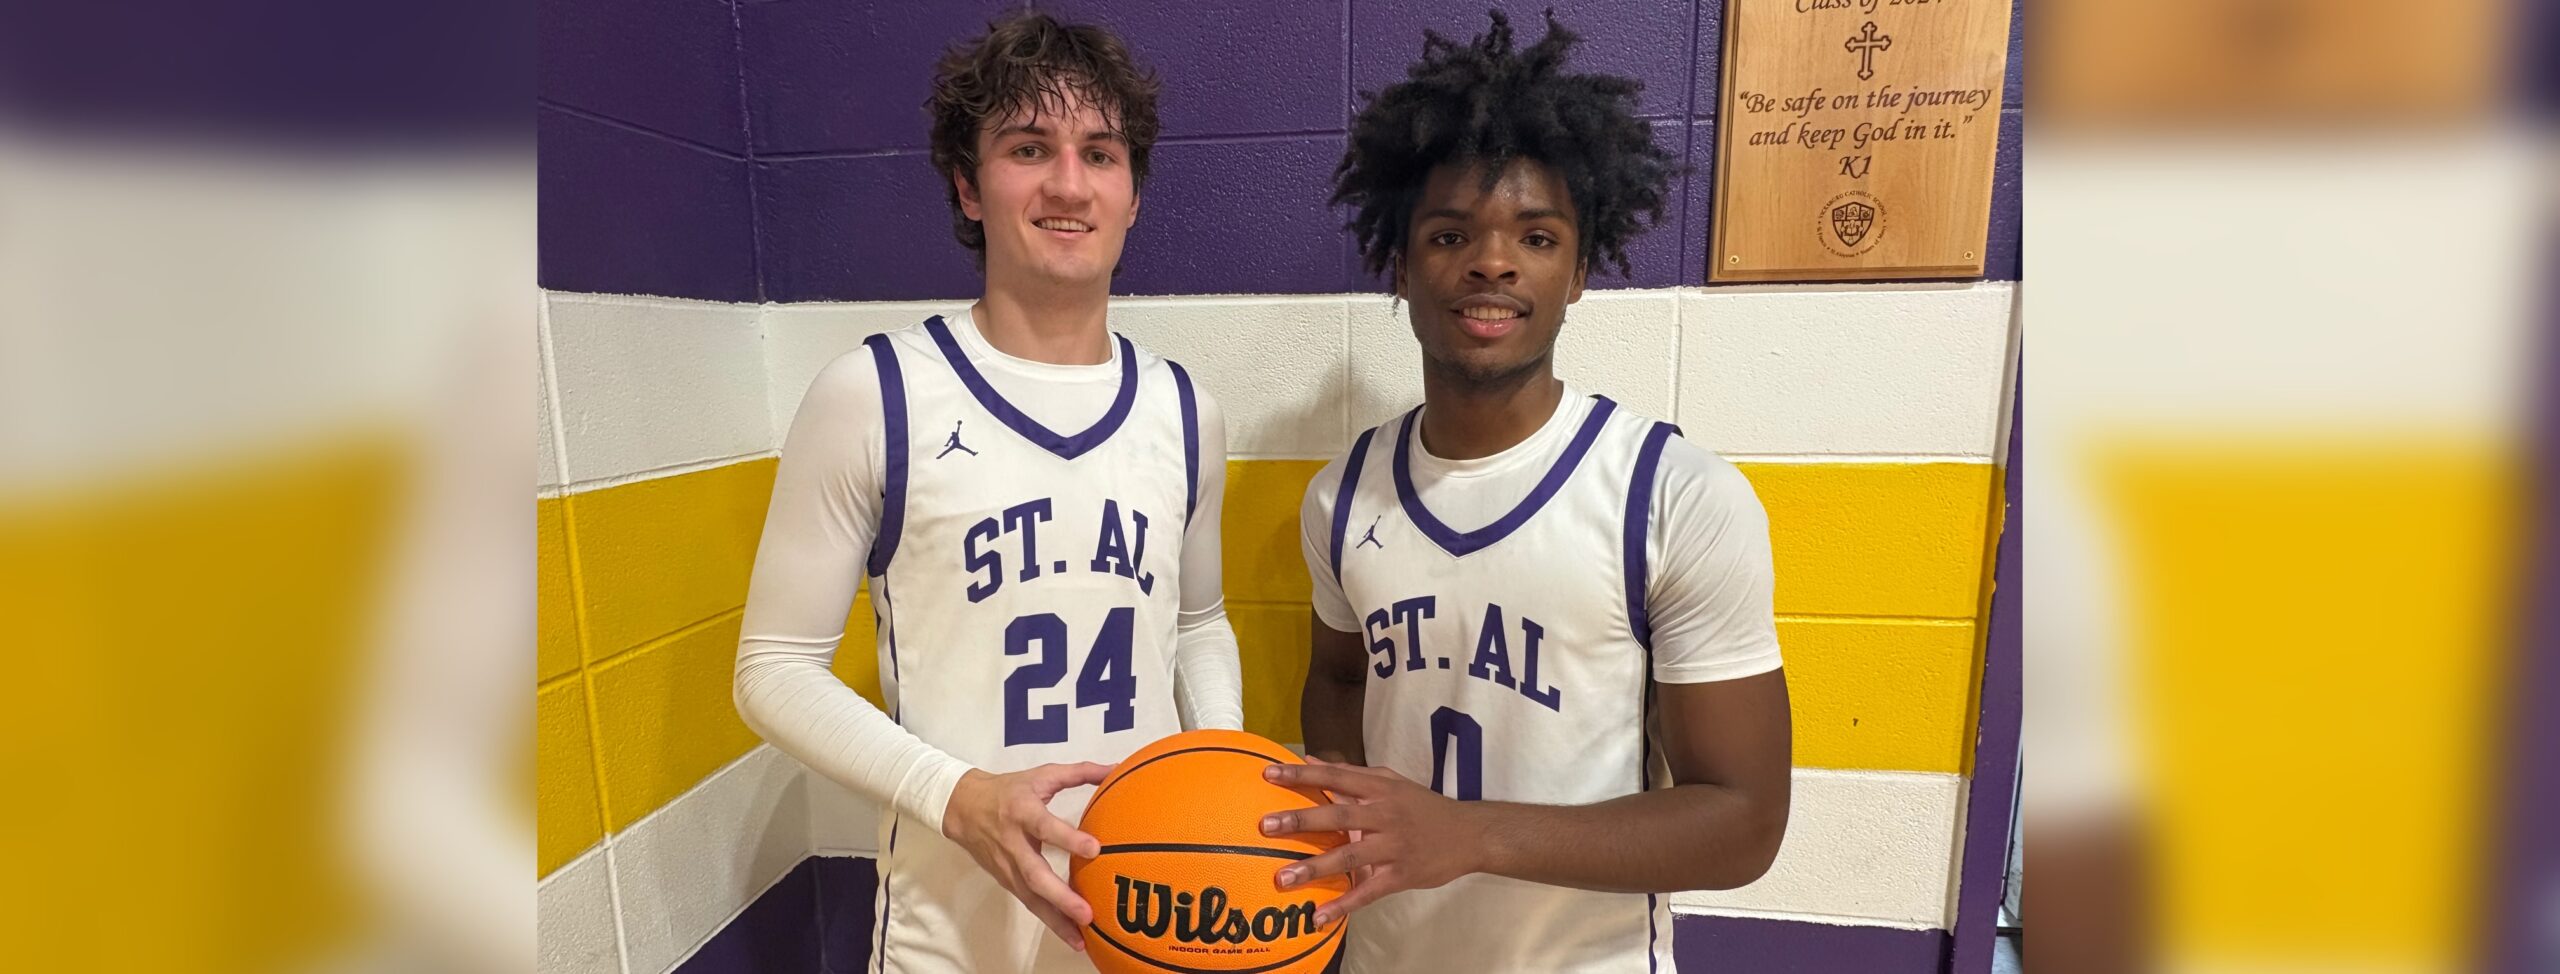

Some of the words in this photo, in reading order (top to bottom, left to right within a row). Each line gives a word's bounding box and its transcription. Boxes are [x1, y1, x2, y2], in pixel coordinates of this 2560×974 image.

[1740, 91, 1776, 113] “Be
[1782, 88, 1826, 118] safe
[1832, 95, 1859, 109] on
[1867, 85, 1901, 108] the
[1900, 86, 1992, 114] journey
[1749, 122, 1796, 146] and
[1797, 122, 1846, 150] keep
[1853, 118, 1904, 149] God
[1905, 120, 1926, 139] in
[1839, 155, 1872, 179] K1
[964, 497, 1067, 604] ST.
[1091, 498, 1155, 597] AL
[1004, 607, 1137, 747] 24
[1366, 595, 1450, 679] ST.
[1468, 602, 1561, 713] AL
[1114, 874, 1317, 944] Wilson
[1168, 945, 1209, 954] INDOOR
